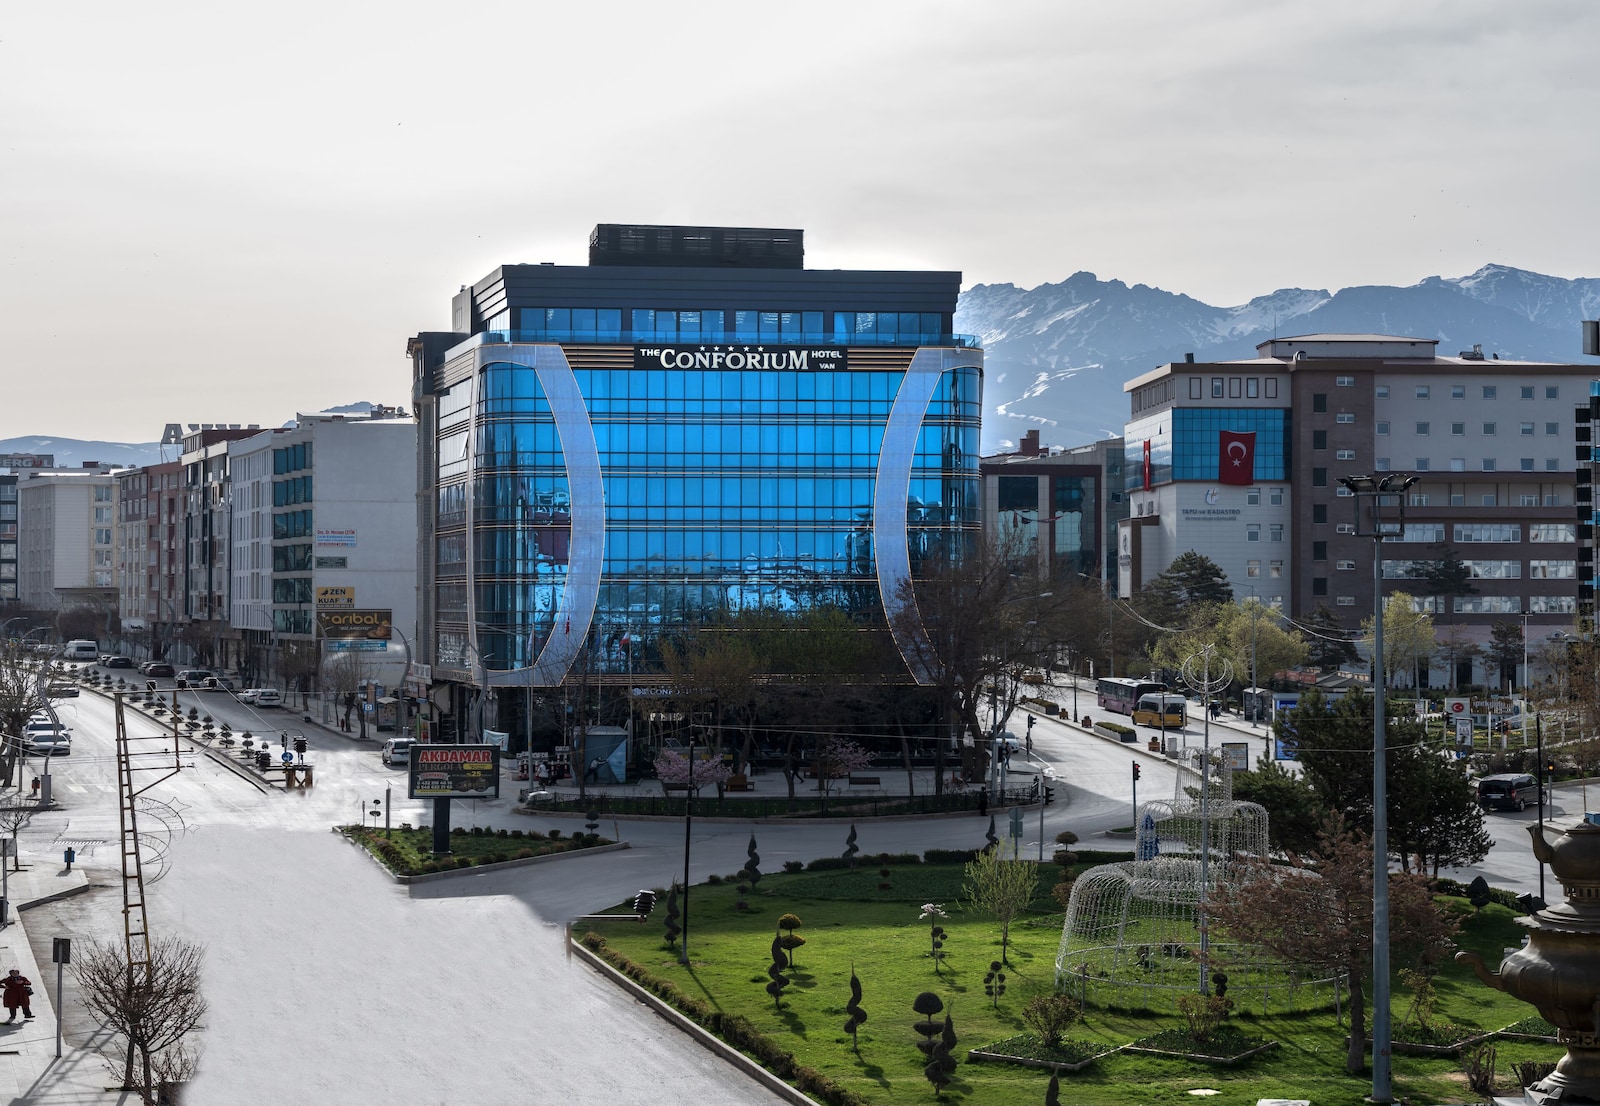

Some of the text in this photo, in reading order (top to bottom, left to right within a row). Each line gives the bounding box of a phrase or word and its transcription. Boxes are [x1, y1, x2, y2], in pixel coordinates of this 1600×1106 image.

[640, 348, 842, 370] THE CONFORIUM HOTEL
[419, 750, 492, 763] AKDAMAR
[419, 763, 462, 771] PERGOLA
